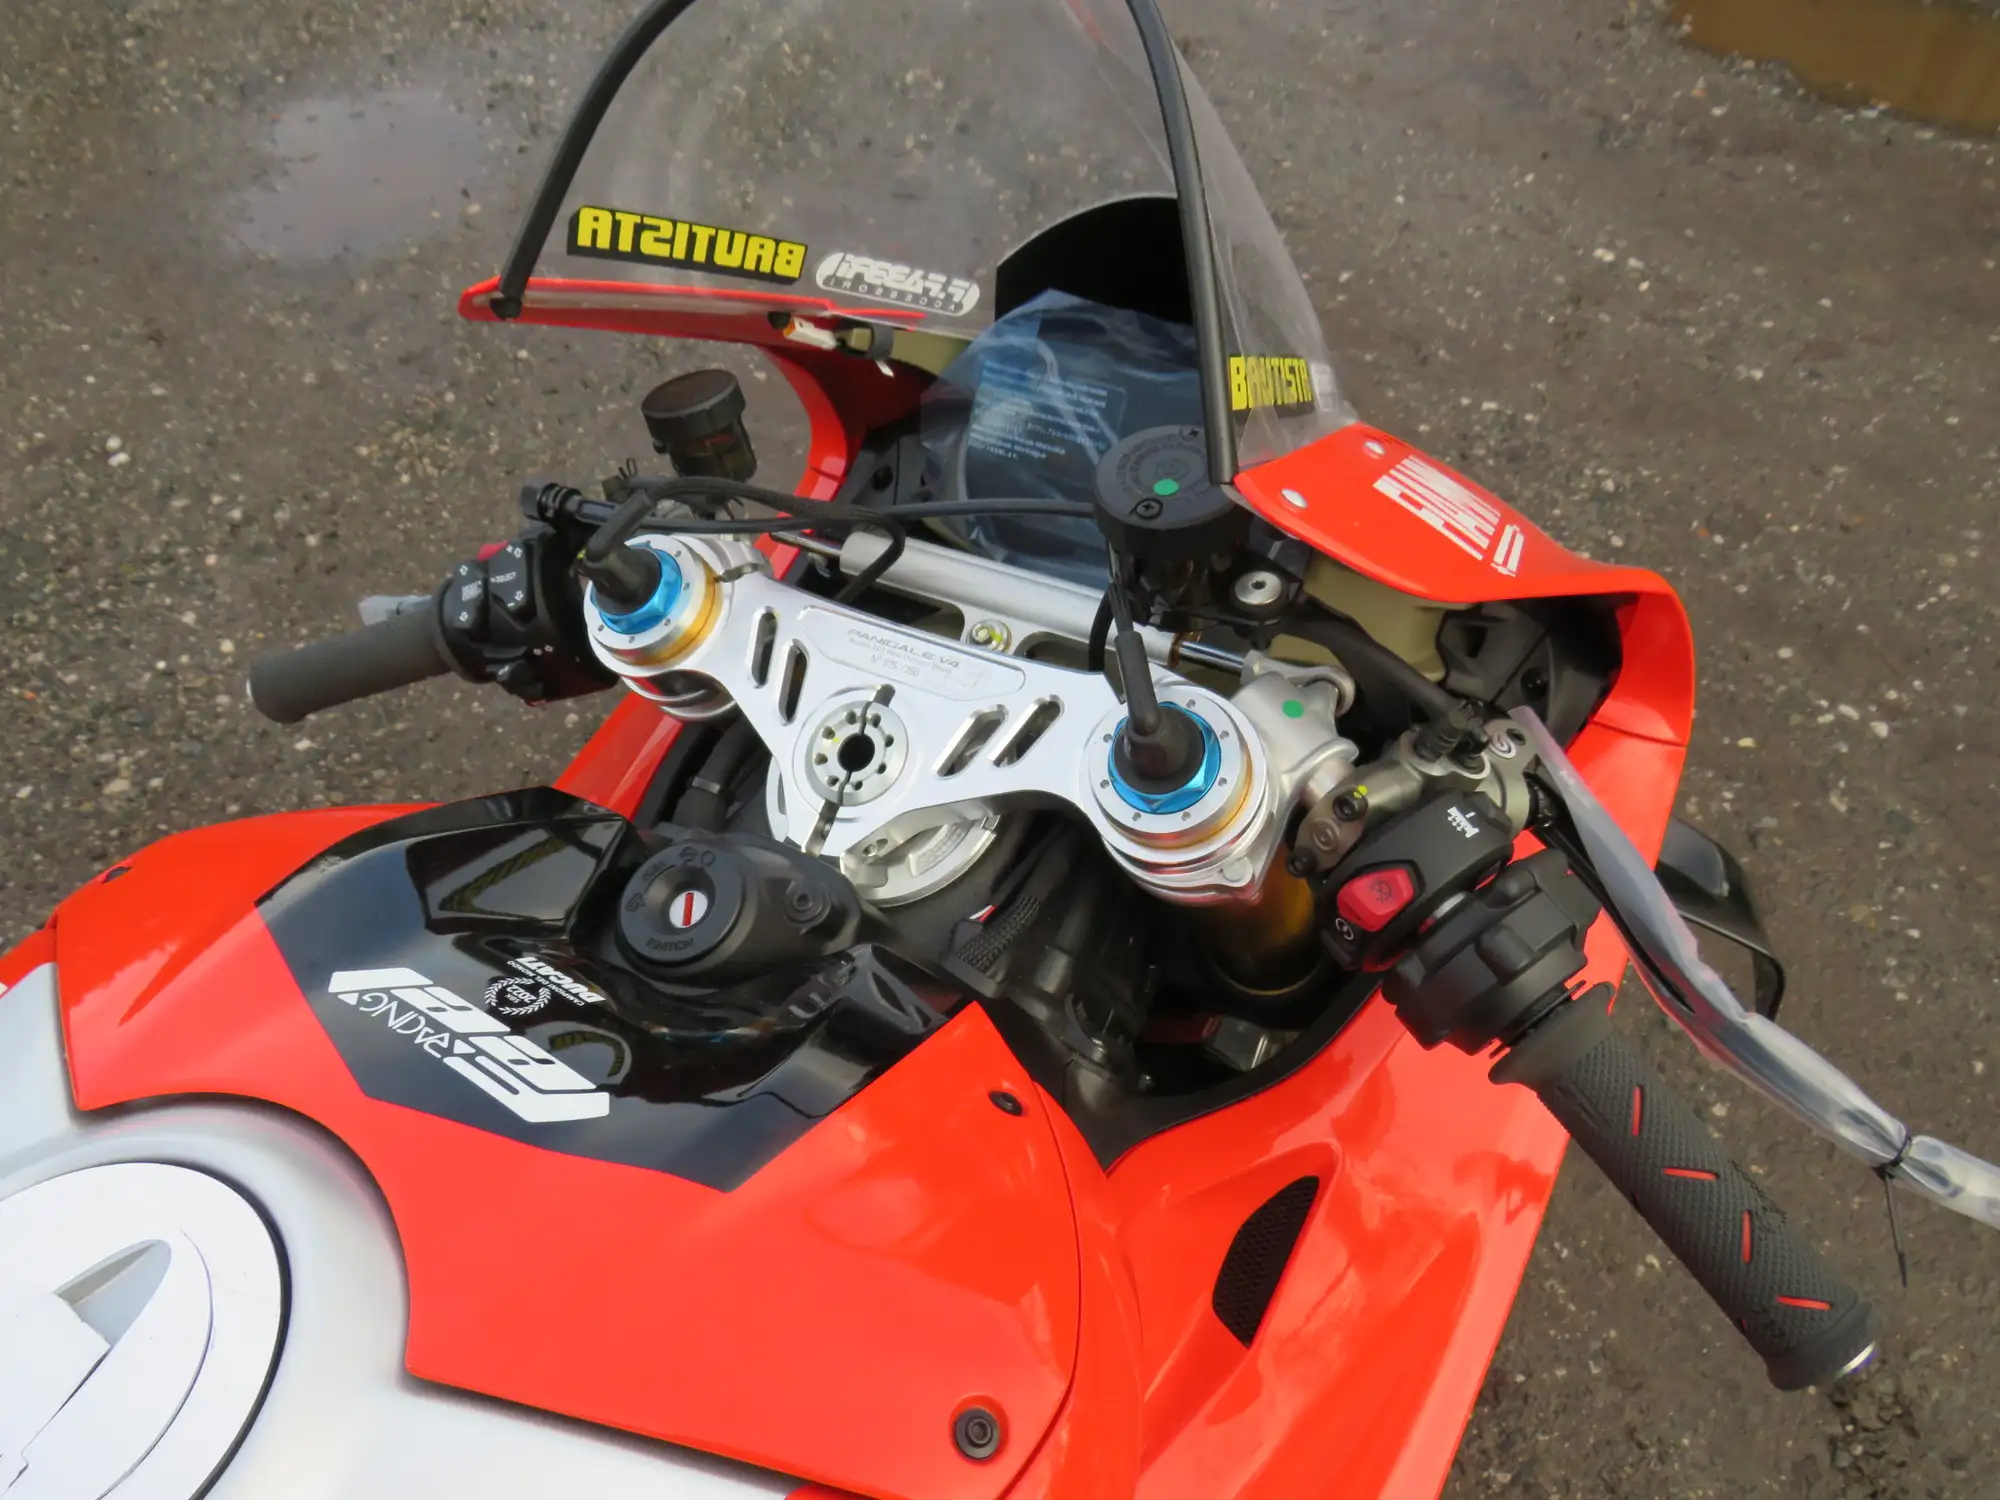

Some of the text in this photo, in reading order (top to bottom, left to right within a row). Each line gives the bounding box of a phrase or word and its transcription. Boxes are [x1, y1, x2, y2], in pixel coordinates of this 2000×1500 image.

[1229, 356, 1313, 410] BAUTISTA
[506, 985, 537, 1004] 2022
[515, 956, 606, 1003] DUCATI
[359, 992, 451, 1059] RACING
